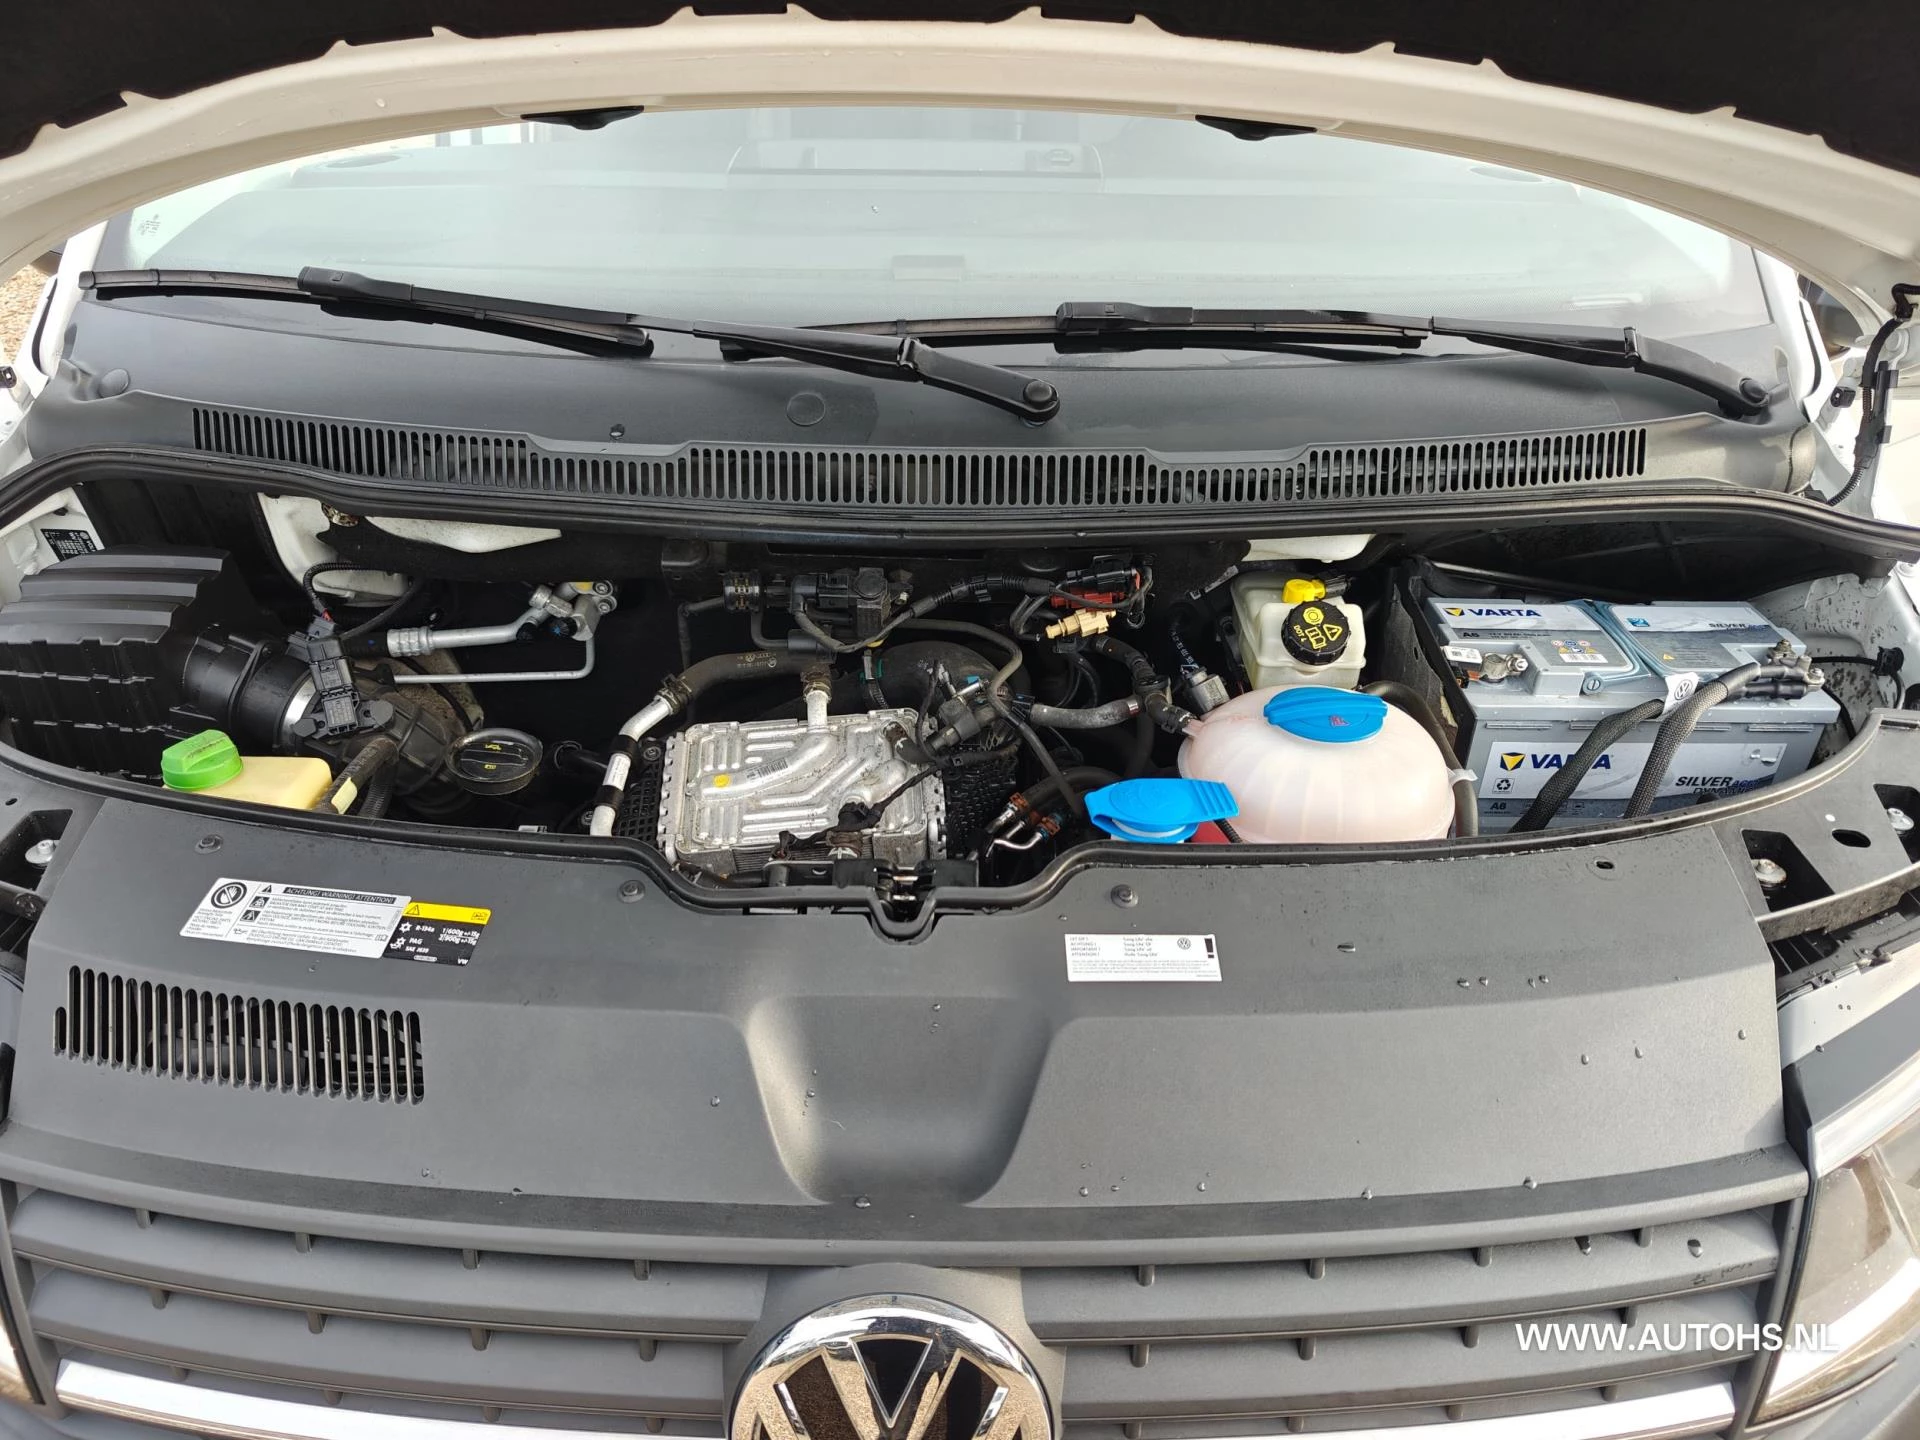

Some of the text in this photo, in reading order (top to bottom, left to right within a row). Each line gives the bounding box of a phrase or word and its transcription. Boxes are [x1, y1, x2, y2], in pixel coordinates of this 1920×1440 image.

[1467, 607, 1543, 618] VARTA
[1293, 624, 1305, 637] DOT
[1675, 776, 1734, 787] SILVER
[286, 887, 394, 905] ACHTUNG! WARNING! ATTENTION!
